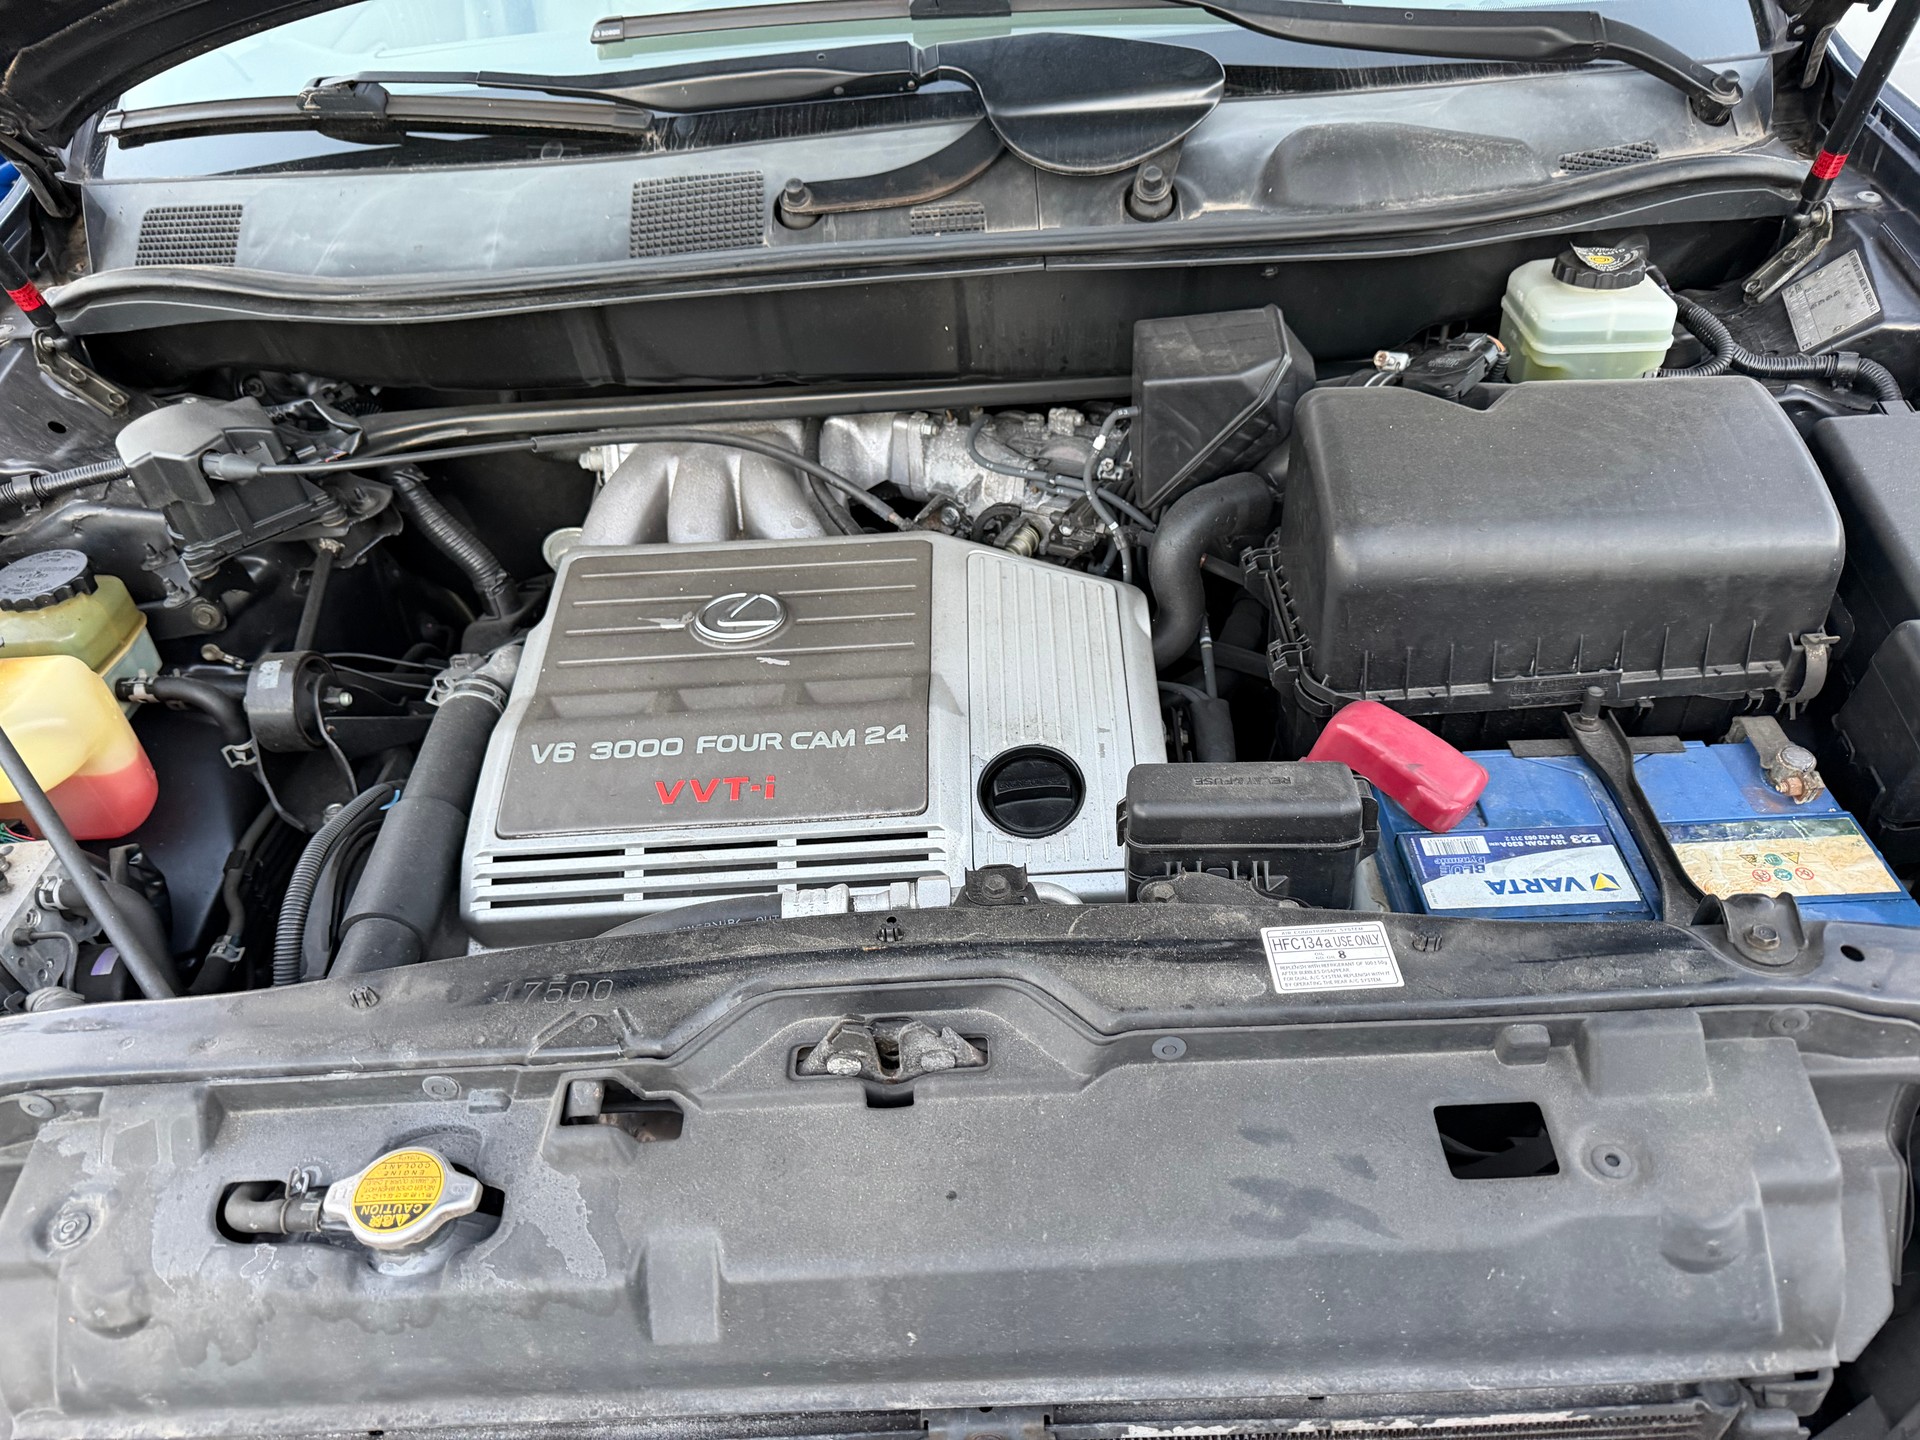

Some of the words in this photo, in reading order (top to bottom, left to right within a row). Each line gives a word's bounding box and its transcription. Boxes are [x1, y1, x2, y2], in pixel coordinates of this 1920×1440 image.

[530, 741, 577, 765] V6
[589, 737, 685, 761] 3000
[696, 732, 784, 755] FOUR
[790, 729, 857, 750] CAM
[865, 725, 910, 746] 24
[654, 774, 776, 806] VVT-i
[1570, 834, 1602, 844] E23
[1434, 856, 1486, 865] Dynamic
[1439, 863, 1486, 877] BLUE
[1484, 877, 1588, 895] VARTA
[1272, 936, 1333, 951] HFC134a
[1334, 936, 1354, 947] USE
[1355, 934, 1380, 946] ONLY
[1338, 950, 1347, 959] 8
[497, 979, 614, 1004] 17500
[384, 1169, 425, 1177] ENGINE
[414, 1184, 435, 1192] NEVER
[360, 1203, 423, 1215] CAUTION
